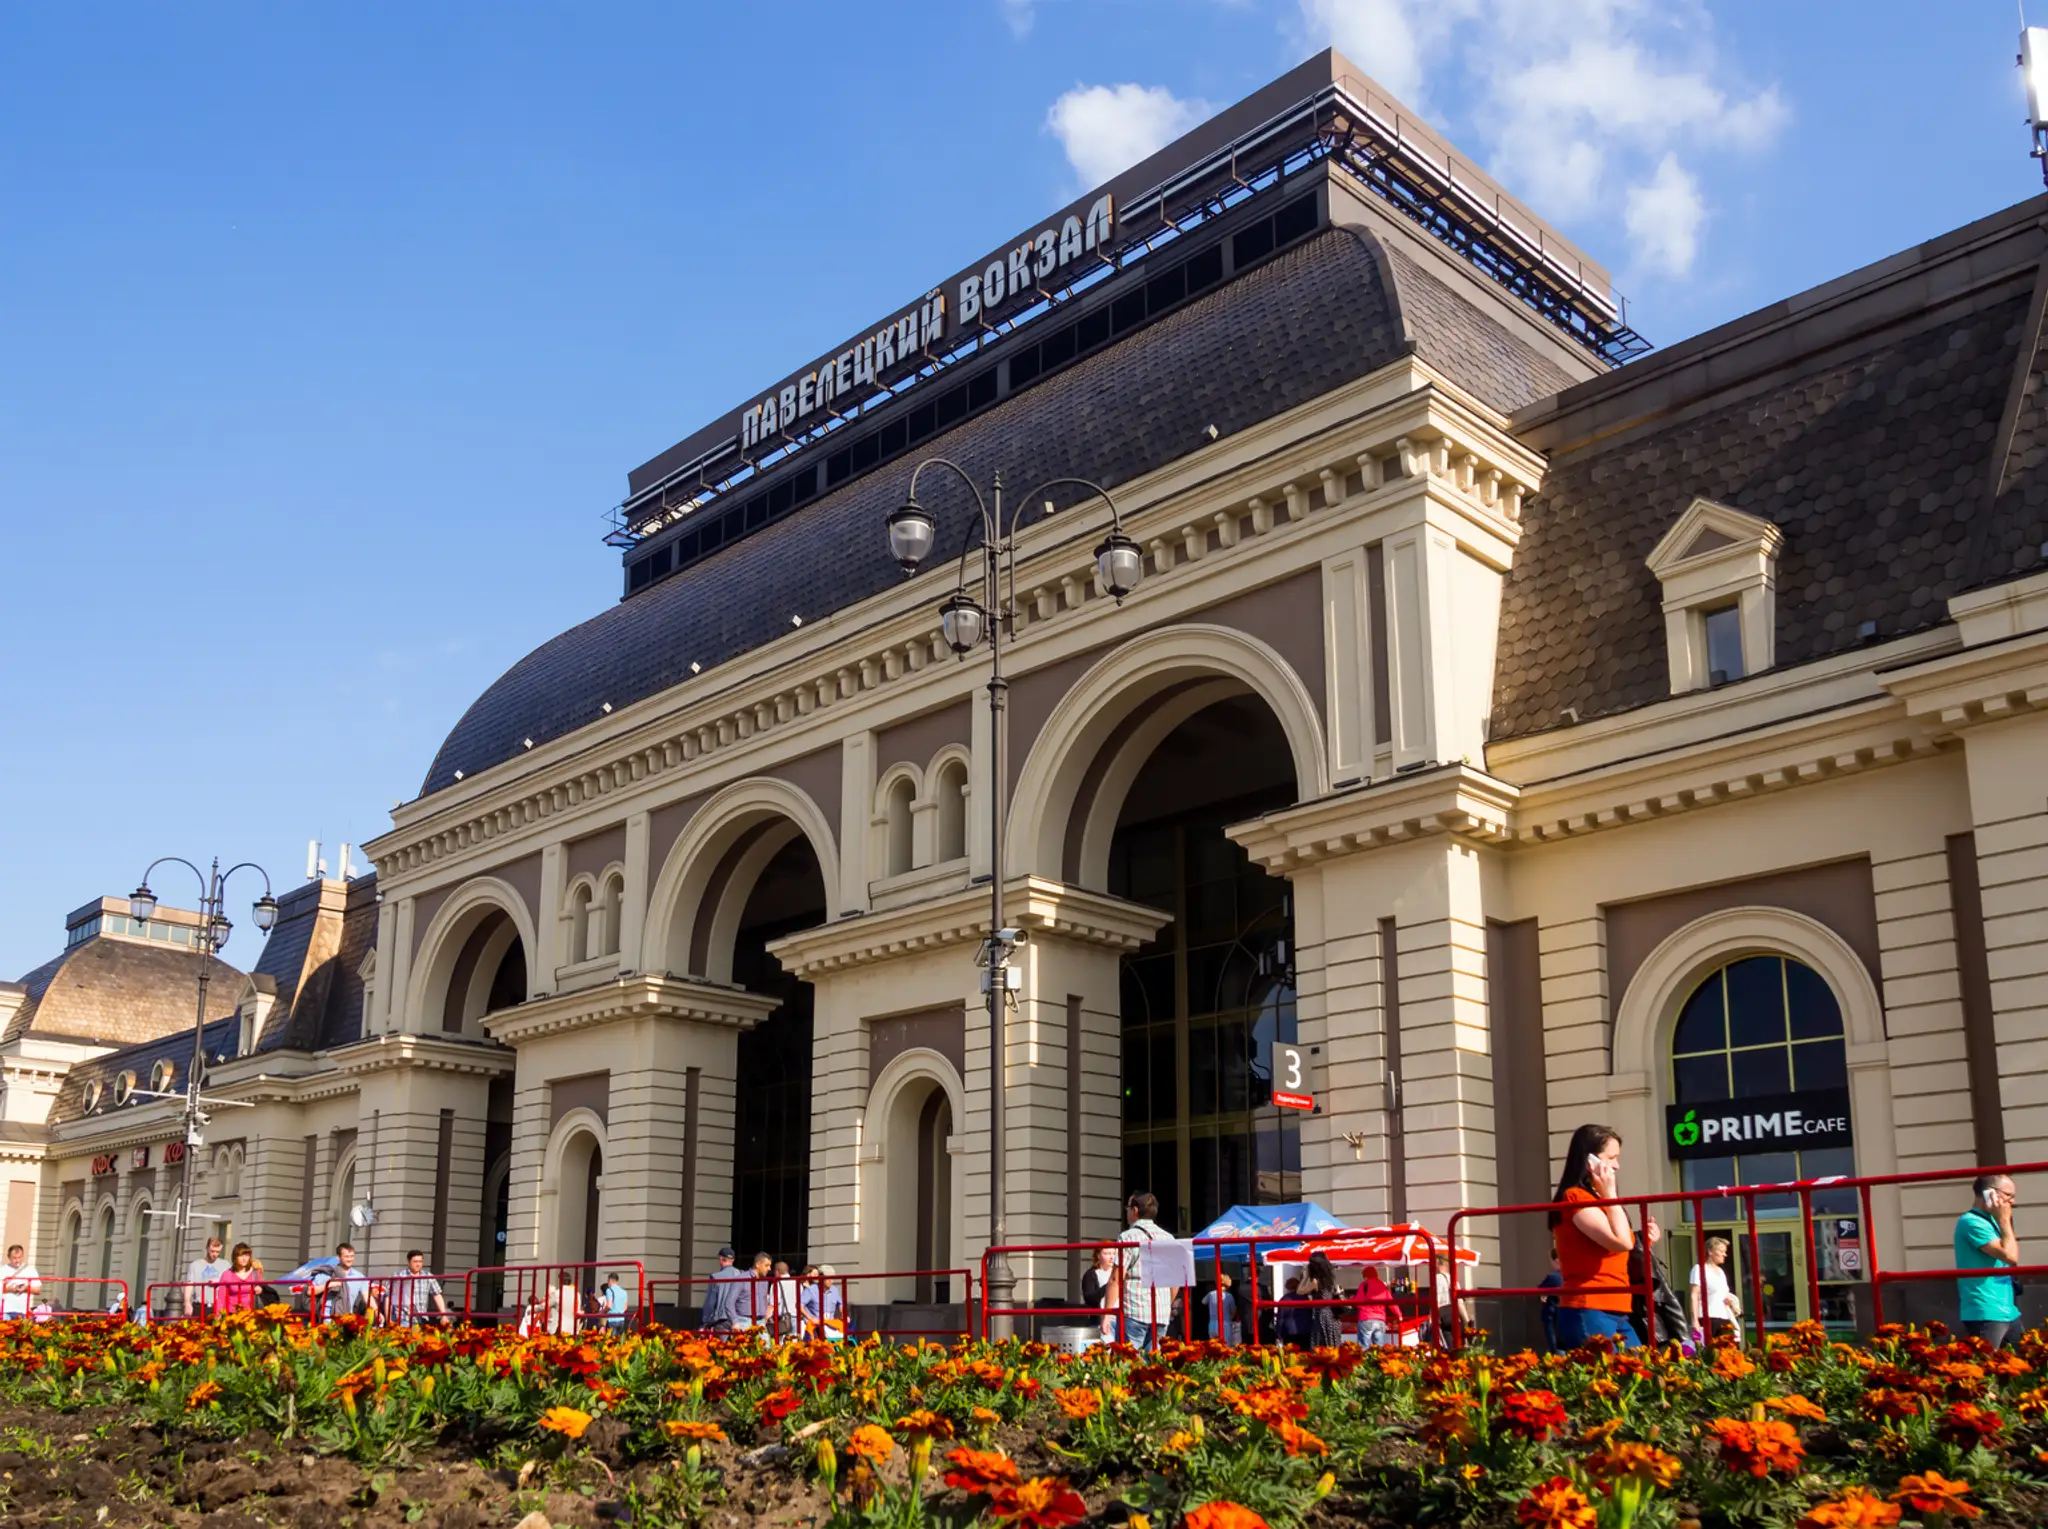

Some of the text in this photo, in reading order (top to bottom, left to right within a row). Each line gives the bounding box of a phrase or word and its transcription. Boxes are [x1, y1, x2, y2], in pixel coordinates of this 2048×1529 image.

[742, 193, 1113, 449] ПАВЕЛЕЦКИЙ ВОКЗАЛ
[1285, 1049, 1302, 1089] 3
[1702, 1110, 1847, 1144] PRIME CAFE
